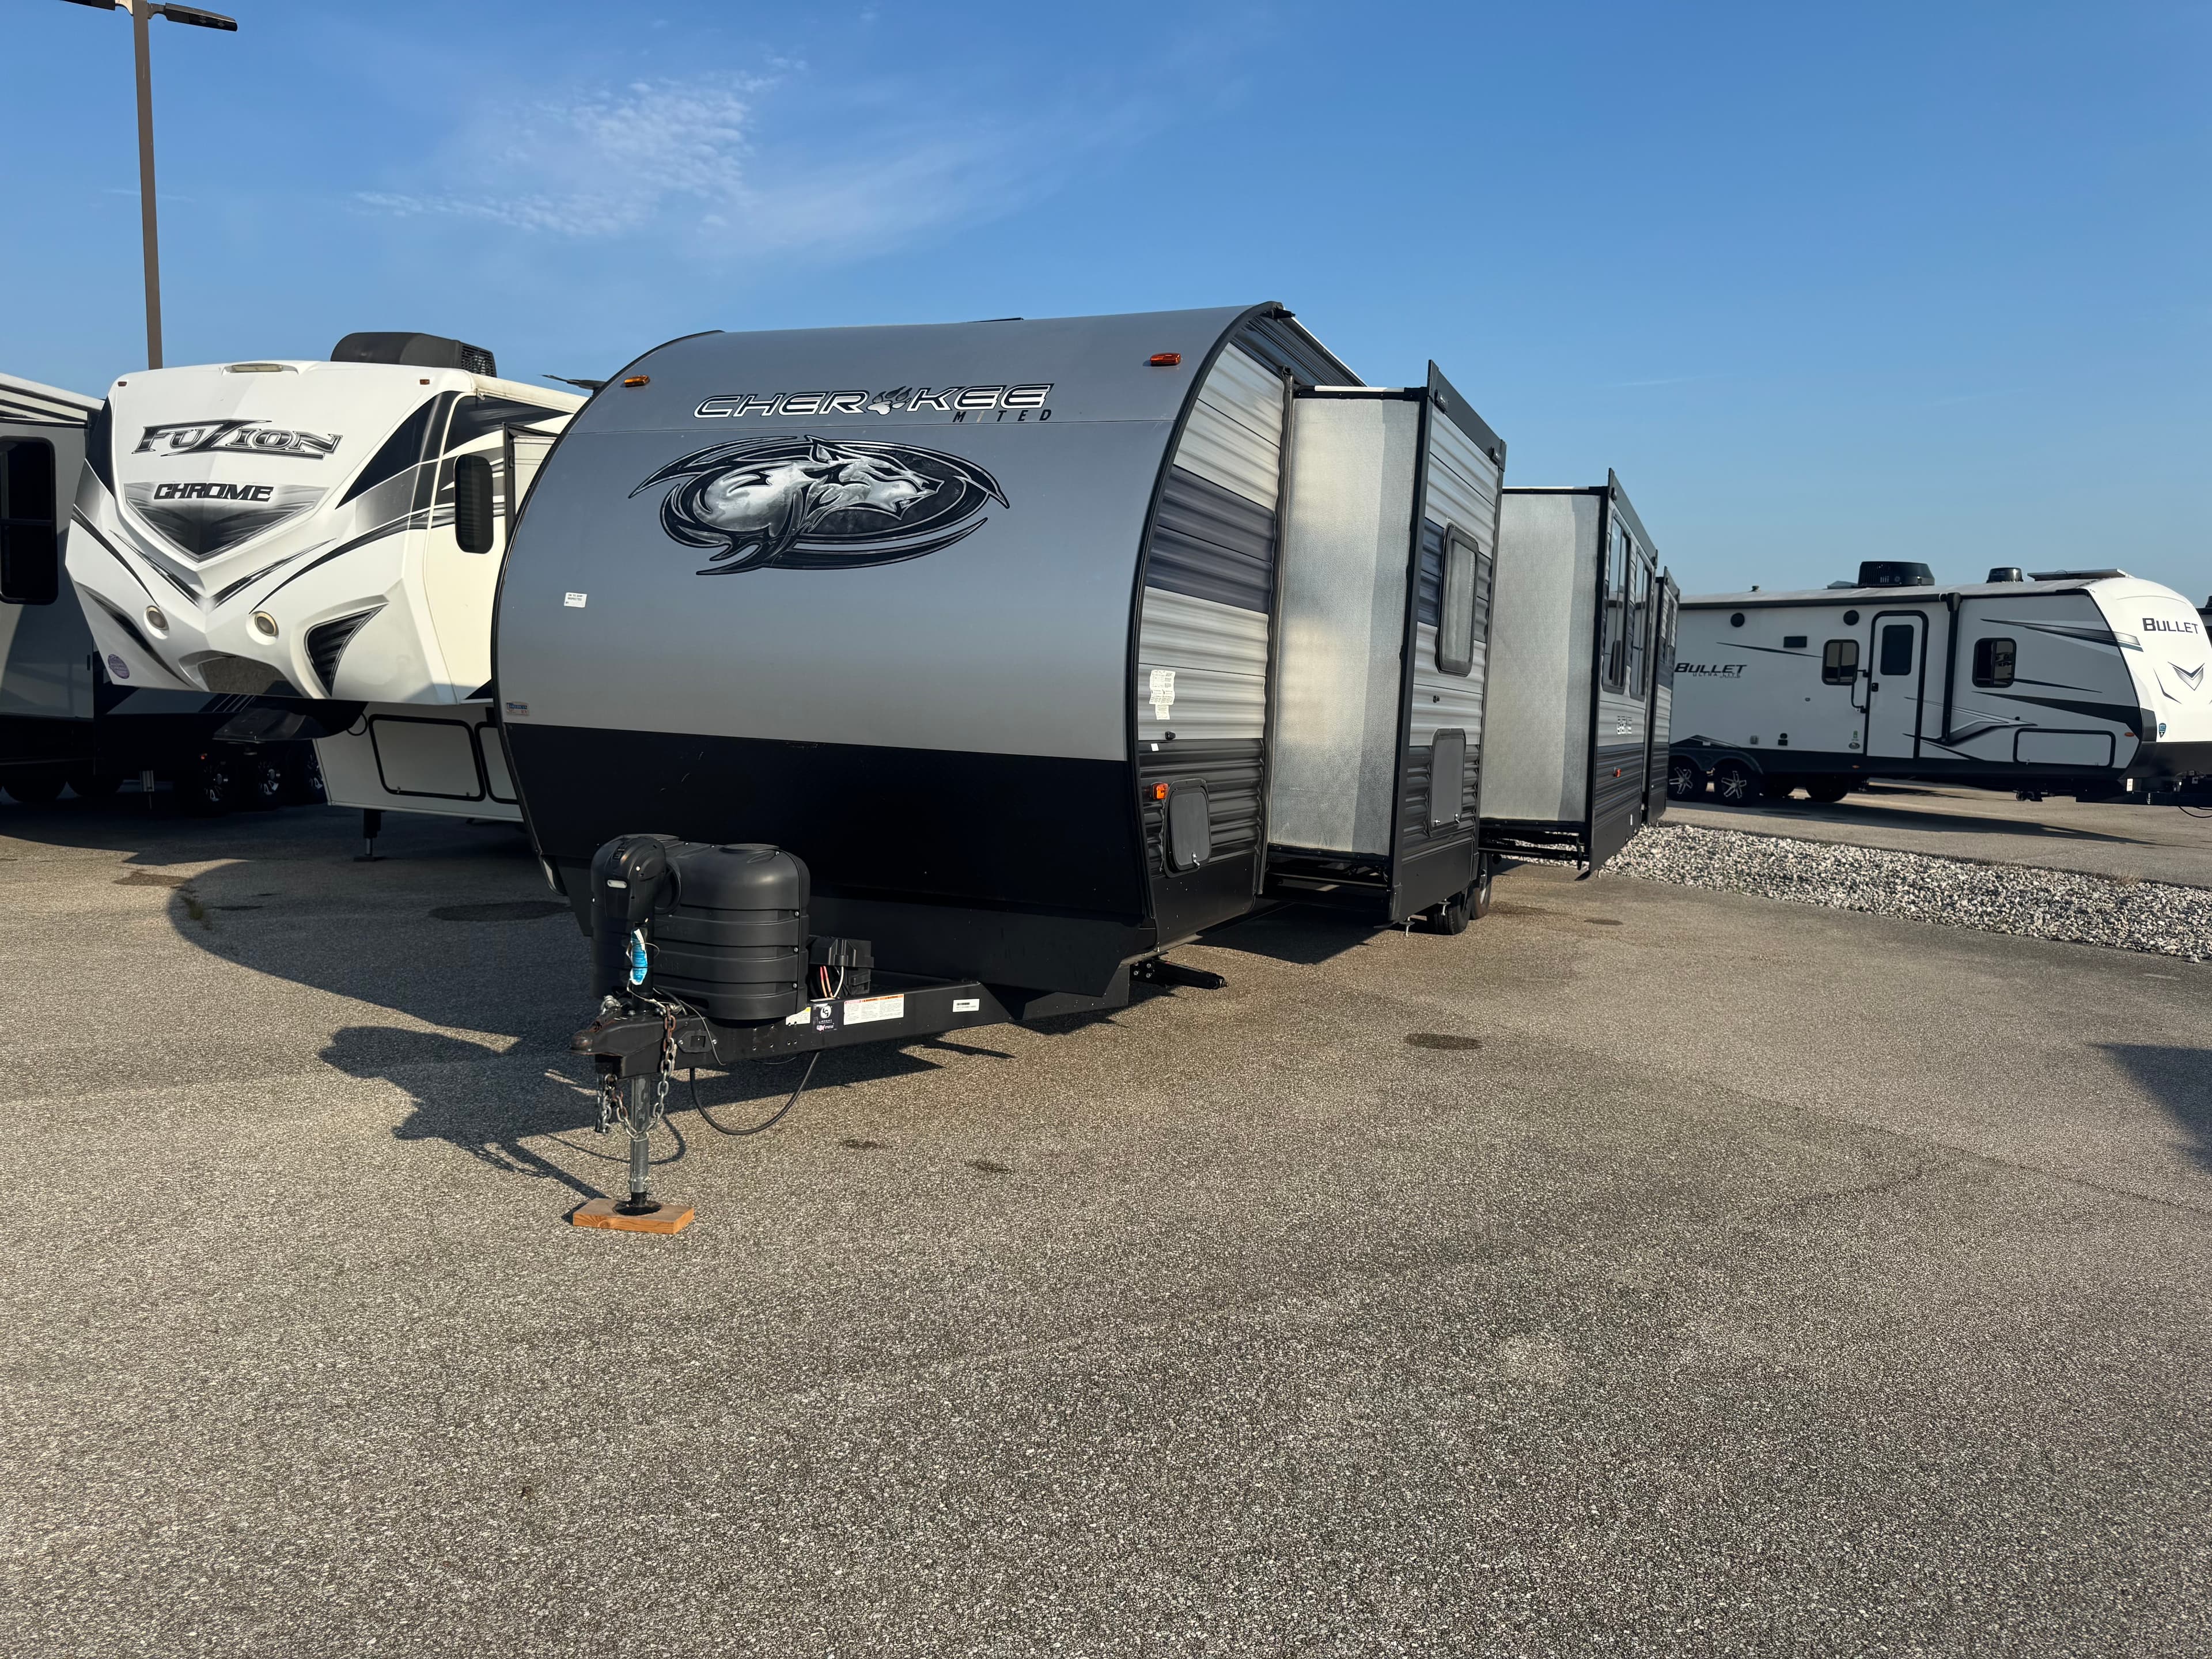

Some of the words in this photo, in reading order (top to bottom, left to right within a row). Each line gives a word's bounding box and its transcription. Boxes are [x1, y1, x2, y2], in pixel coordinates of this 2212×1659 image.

[153, 483, 274, 502] CHROME
[2142, 618, 2198, 634] BULLET
[1674, 662, 1747, 673] BULLET
